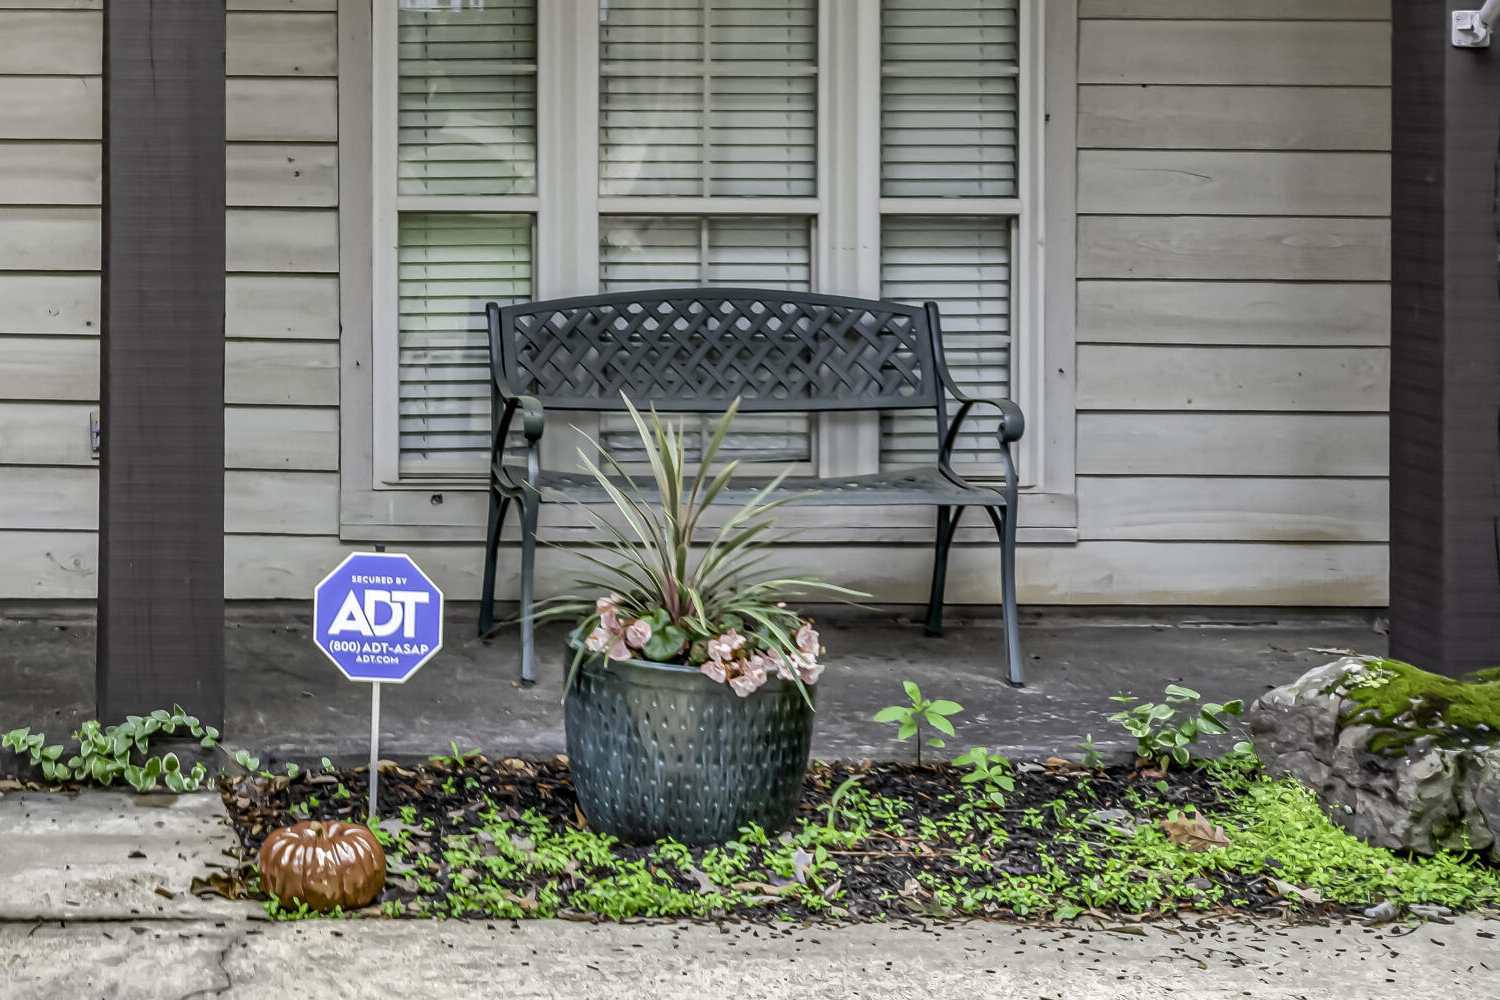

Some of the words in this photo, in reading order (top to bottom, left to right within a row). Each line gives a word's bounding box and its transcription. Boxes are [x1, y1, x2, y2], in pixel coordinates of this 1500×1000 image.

[351, 575, 393, 584] SECURED
[395, 576, 407, 585] BY
[327, 589, 429, 638] ADT
[356, 655, 399, 664] ADT.COM
